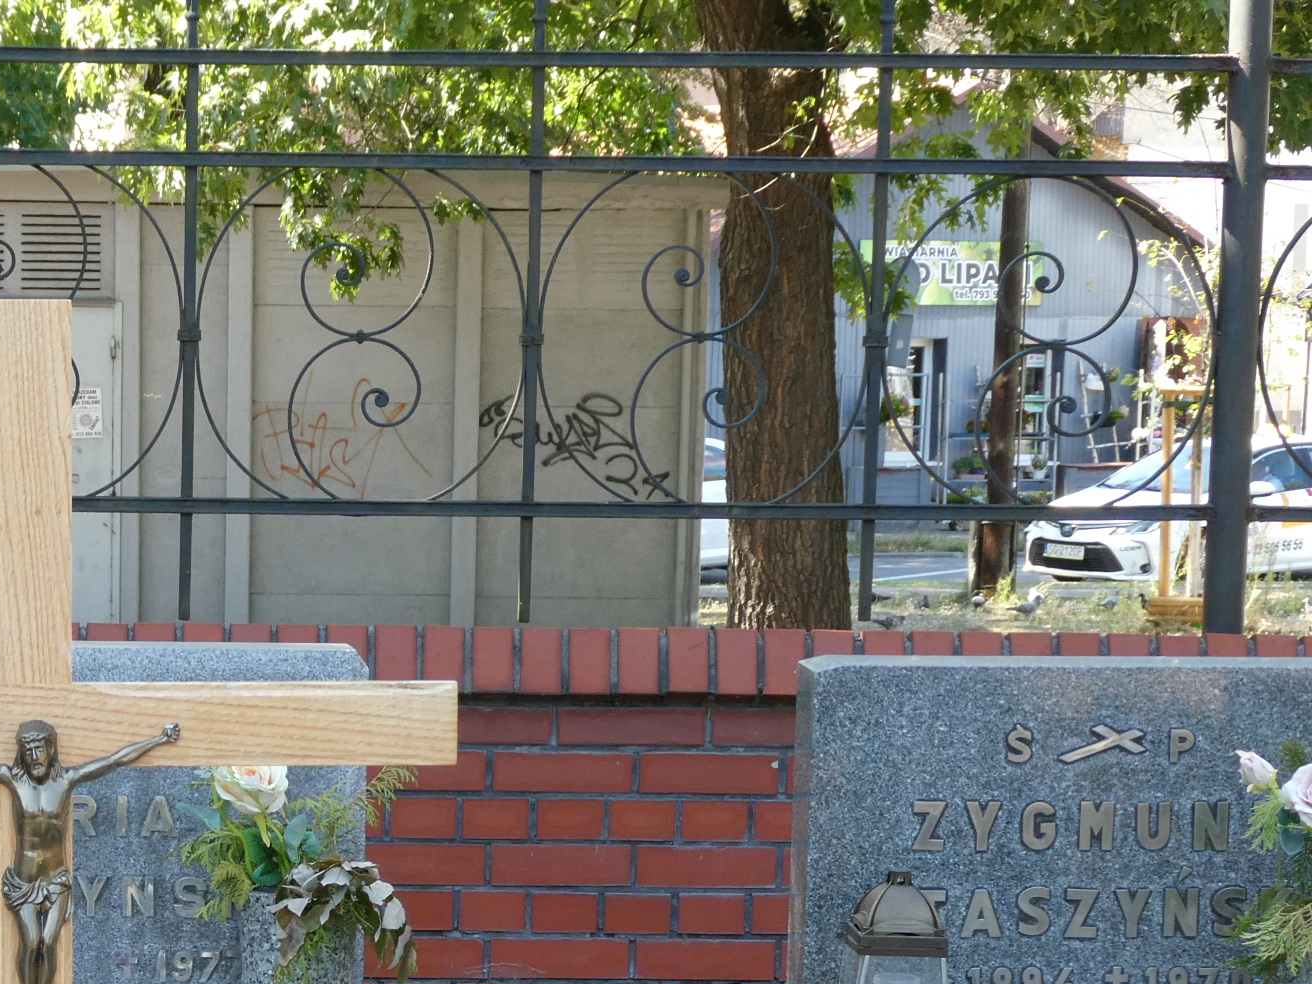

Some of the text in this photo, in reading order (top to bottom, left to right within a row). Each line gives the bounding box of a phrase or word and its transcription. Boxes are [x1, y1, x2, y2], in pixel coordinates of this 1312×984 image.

[940, 262, 1031, 285] LIPAI
[954, 288, 971, 299] tel.
[1169, 728, 1195, 763] P
[912, 801, 1266, 851] ZYGMUN
[156, 950, 242, 984] 1977
